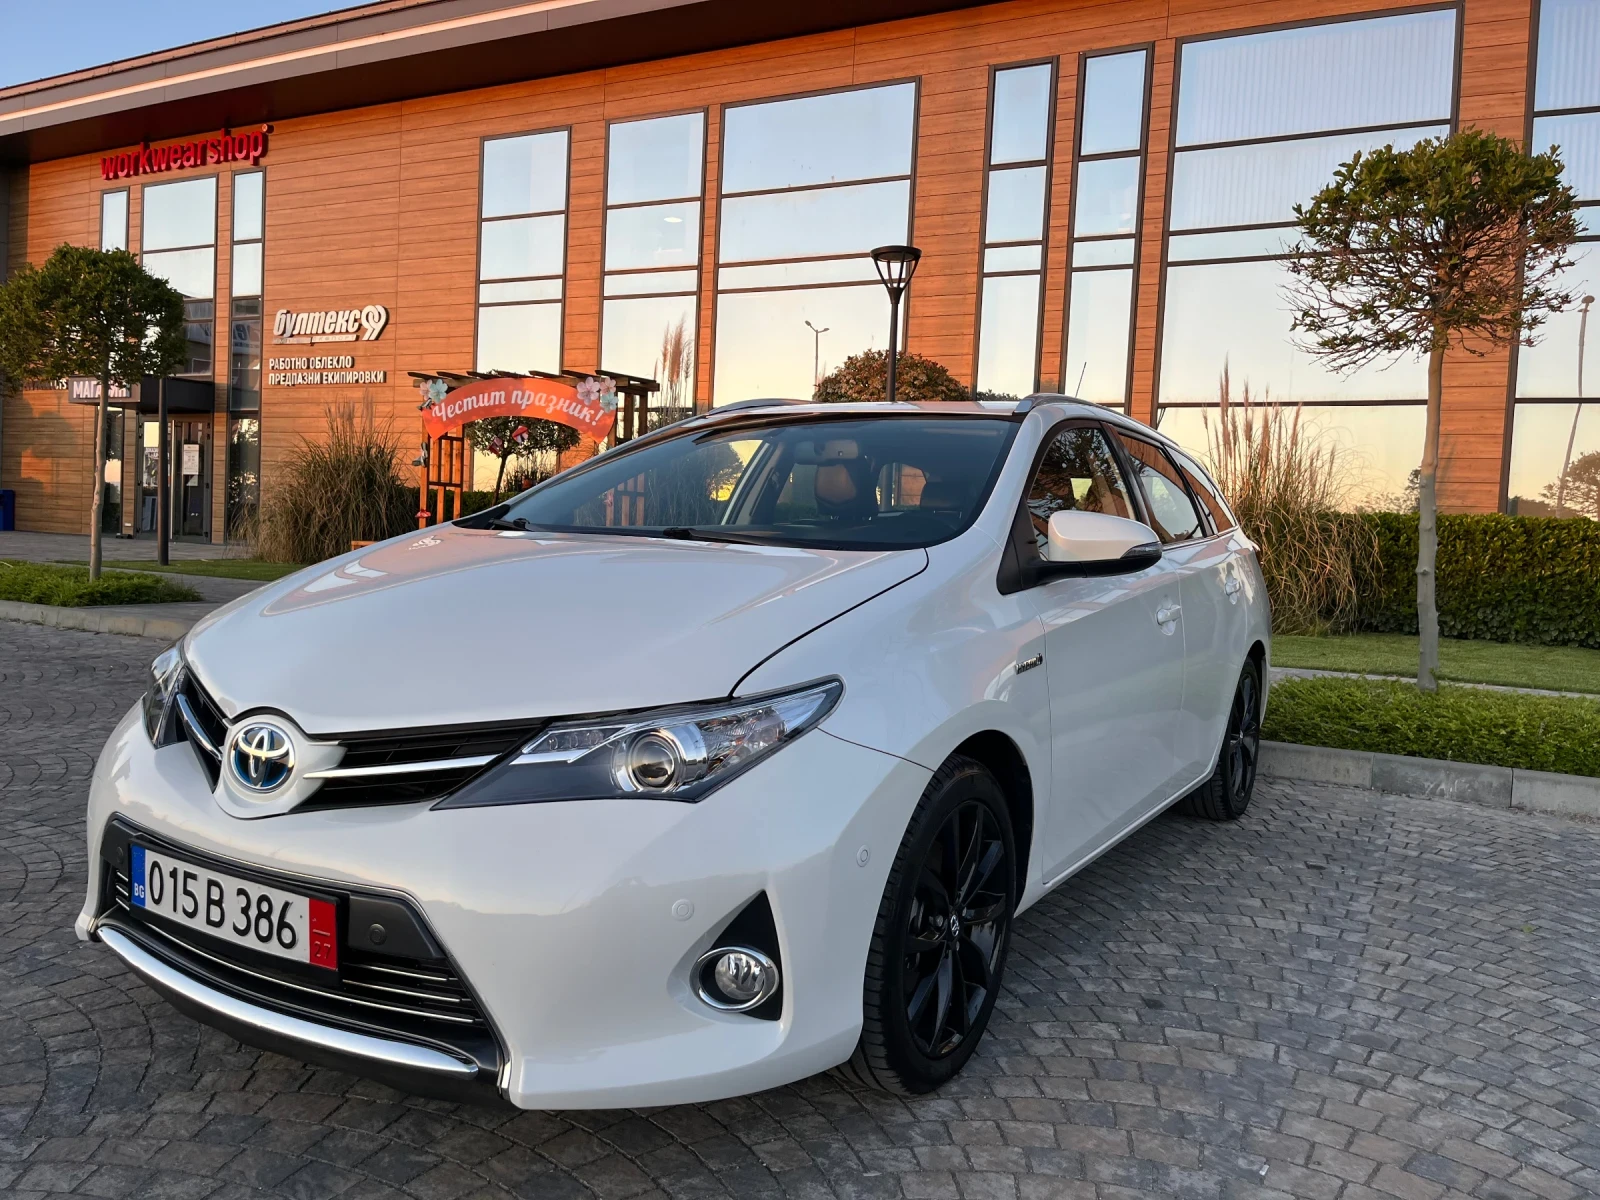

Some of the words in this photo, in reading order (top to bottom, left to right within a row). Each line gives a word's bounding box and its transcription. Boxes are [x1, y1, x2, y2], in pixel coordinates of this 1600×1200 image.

[101, 128, 263, 180] workwearshop
[269, 357, 308, 370] РАБОТНО
[310, 355, 352, 369] ОБЛЕКЛО
[268, 372, 320, 387] ПРЕДПАЗНИ
[322, 370, 384, 384] ЕКИПИРОВКИ
[73, 380, 128, 399] МАГАИН
[432, 391, 505, 422] Честит
[511, 390, 604, 426] празник!
[134, 882, 145, 899] BG
